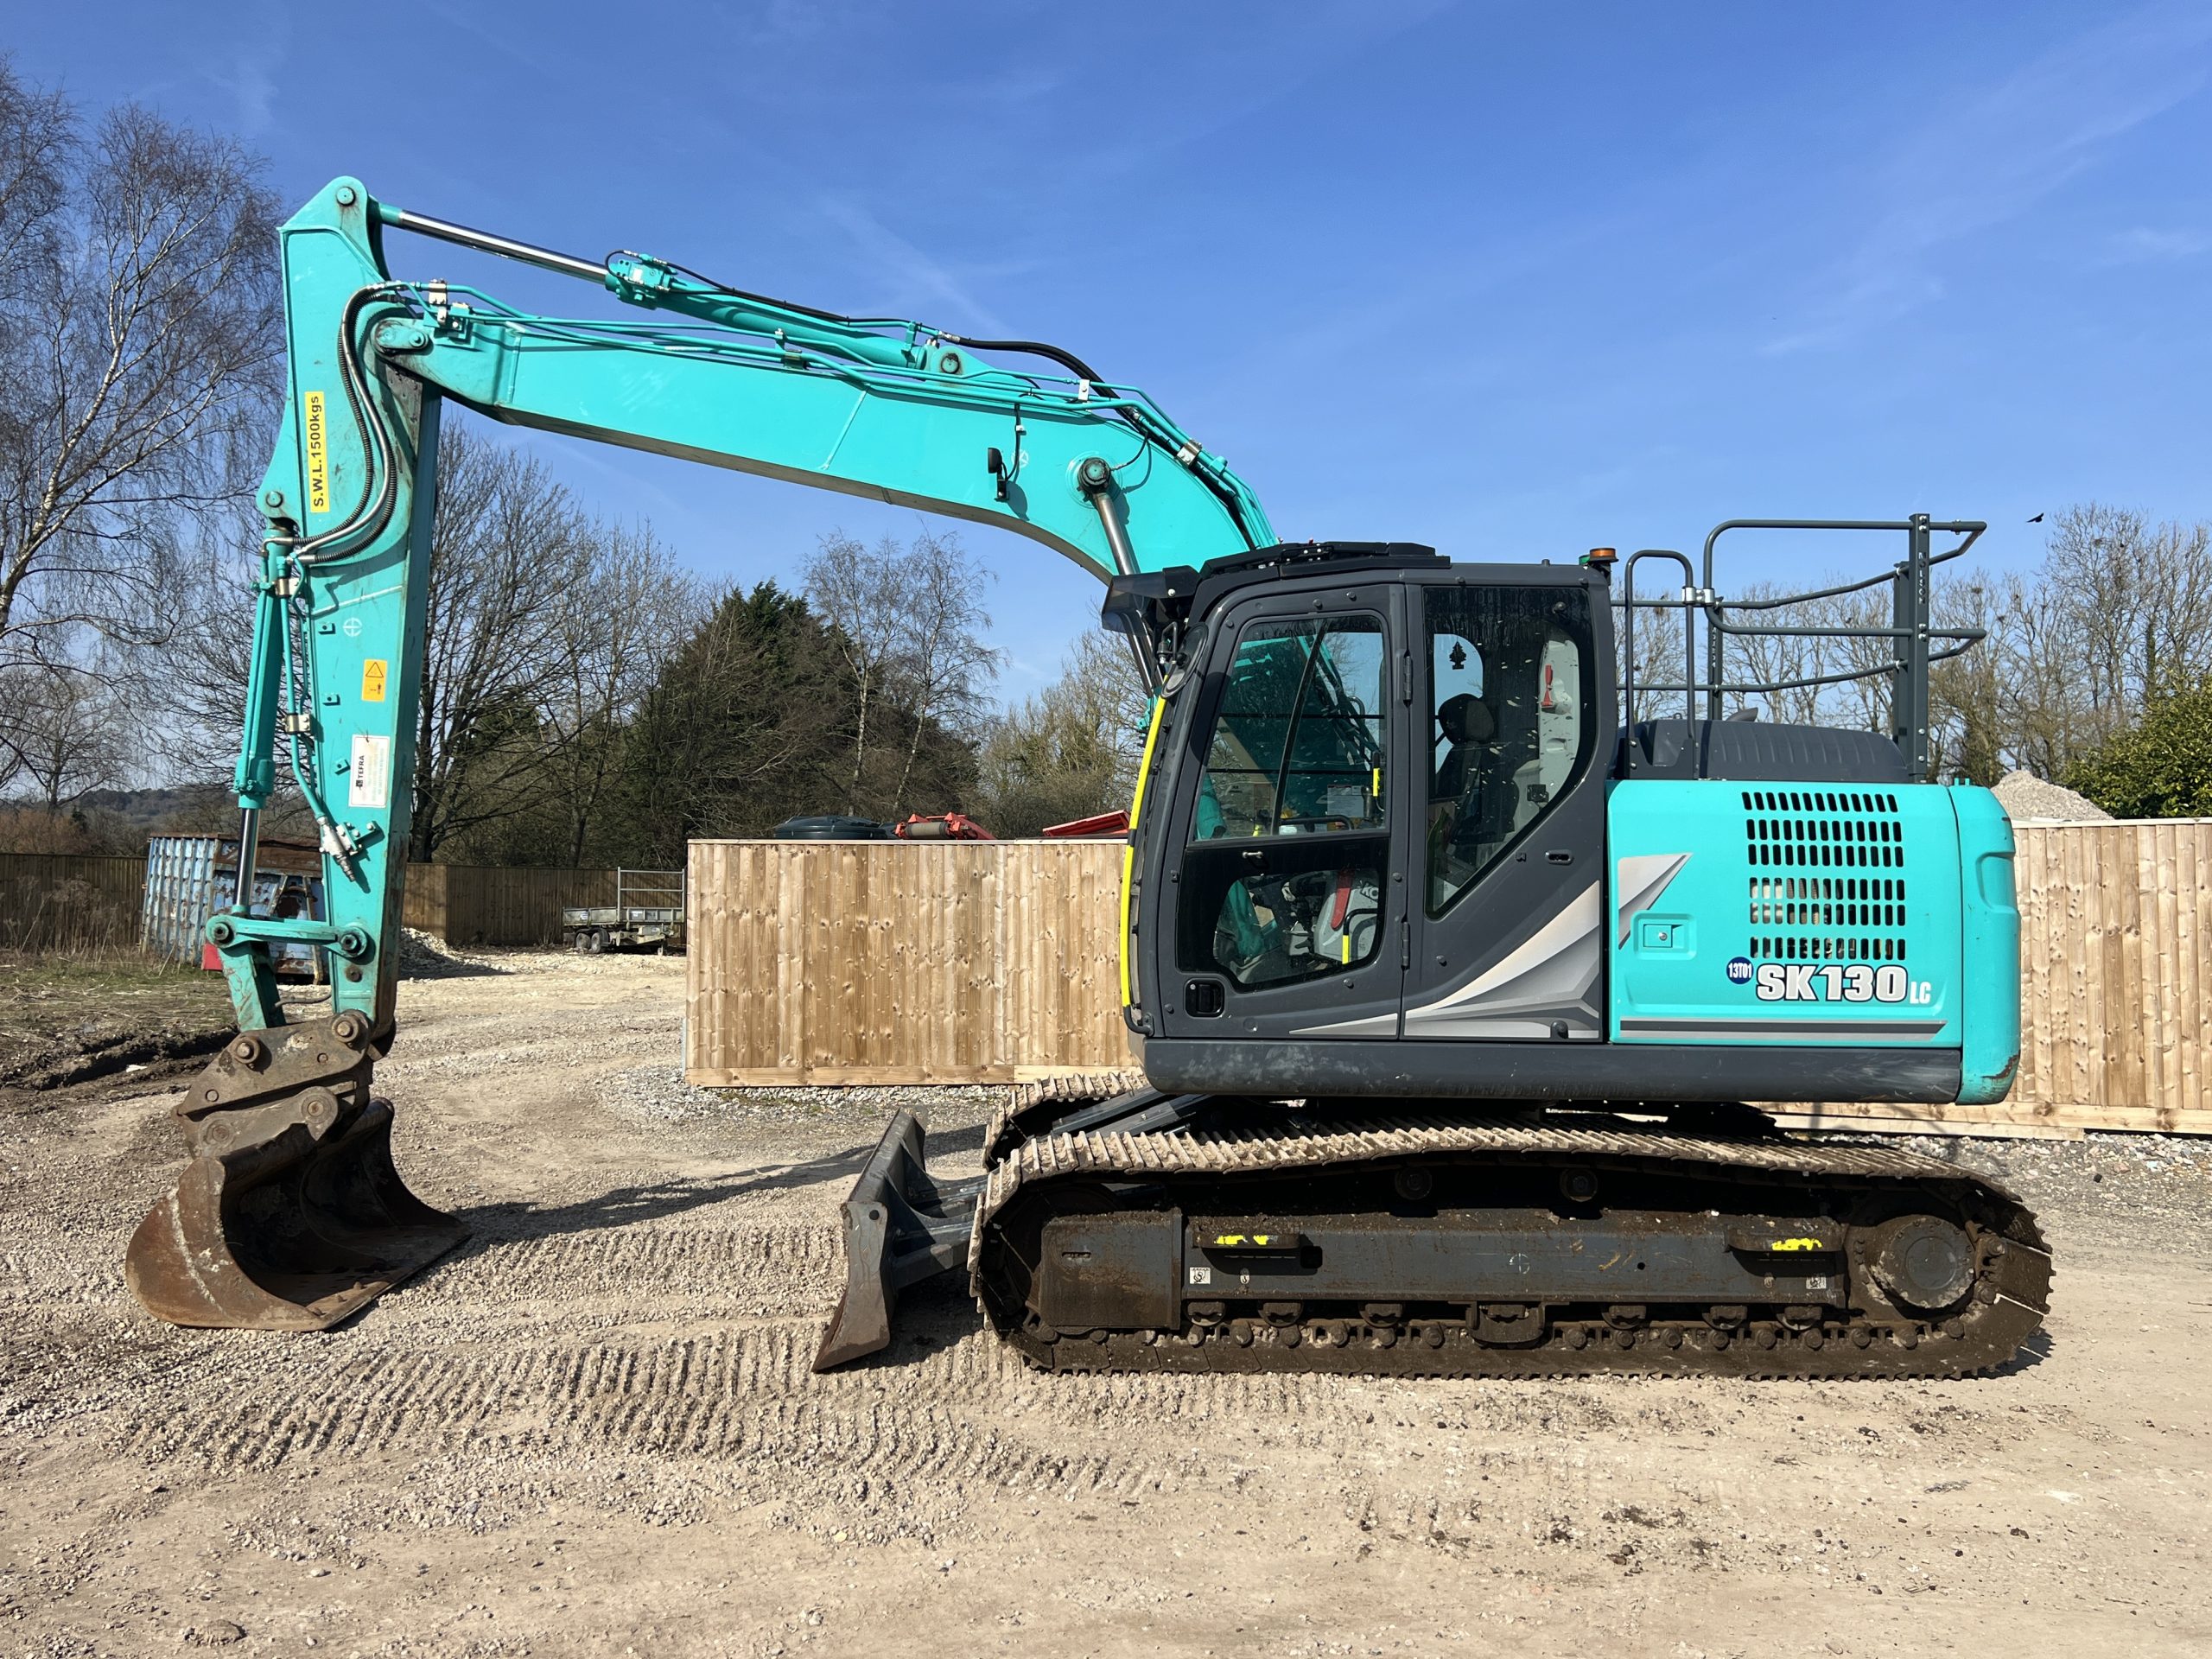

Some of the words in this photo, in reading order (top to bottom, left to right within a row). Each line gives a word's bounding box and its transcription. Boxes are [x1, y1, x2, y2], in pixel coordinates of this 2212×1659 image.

[1728, 962, 1752, 979] 13T01
[1756, 963, 1908, 1002] SK130
[1910, 982, 1931, 1004] LC
